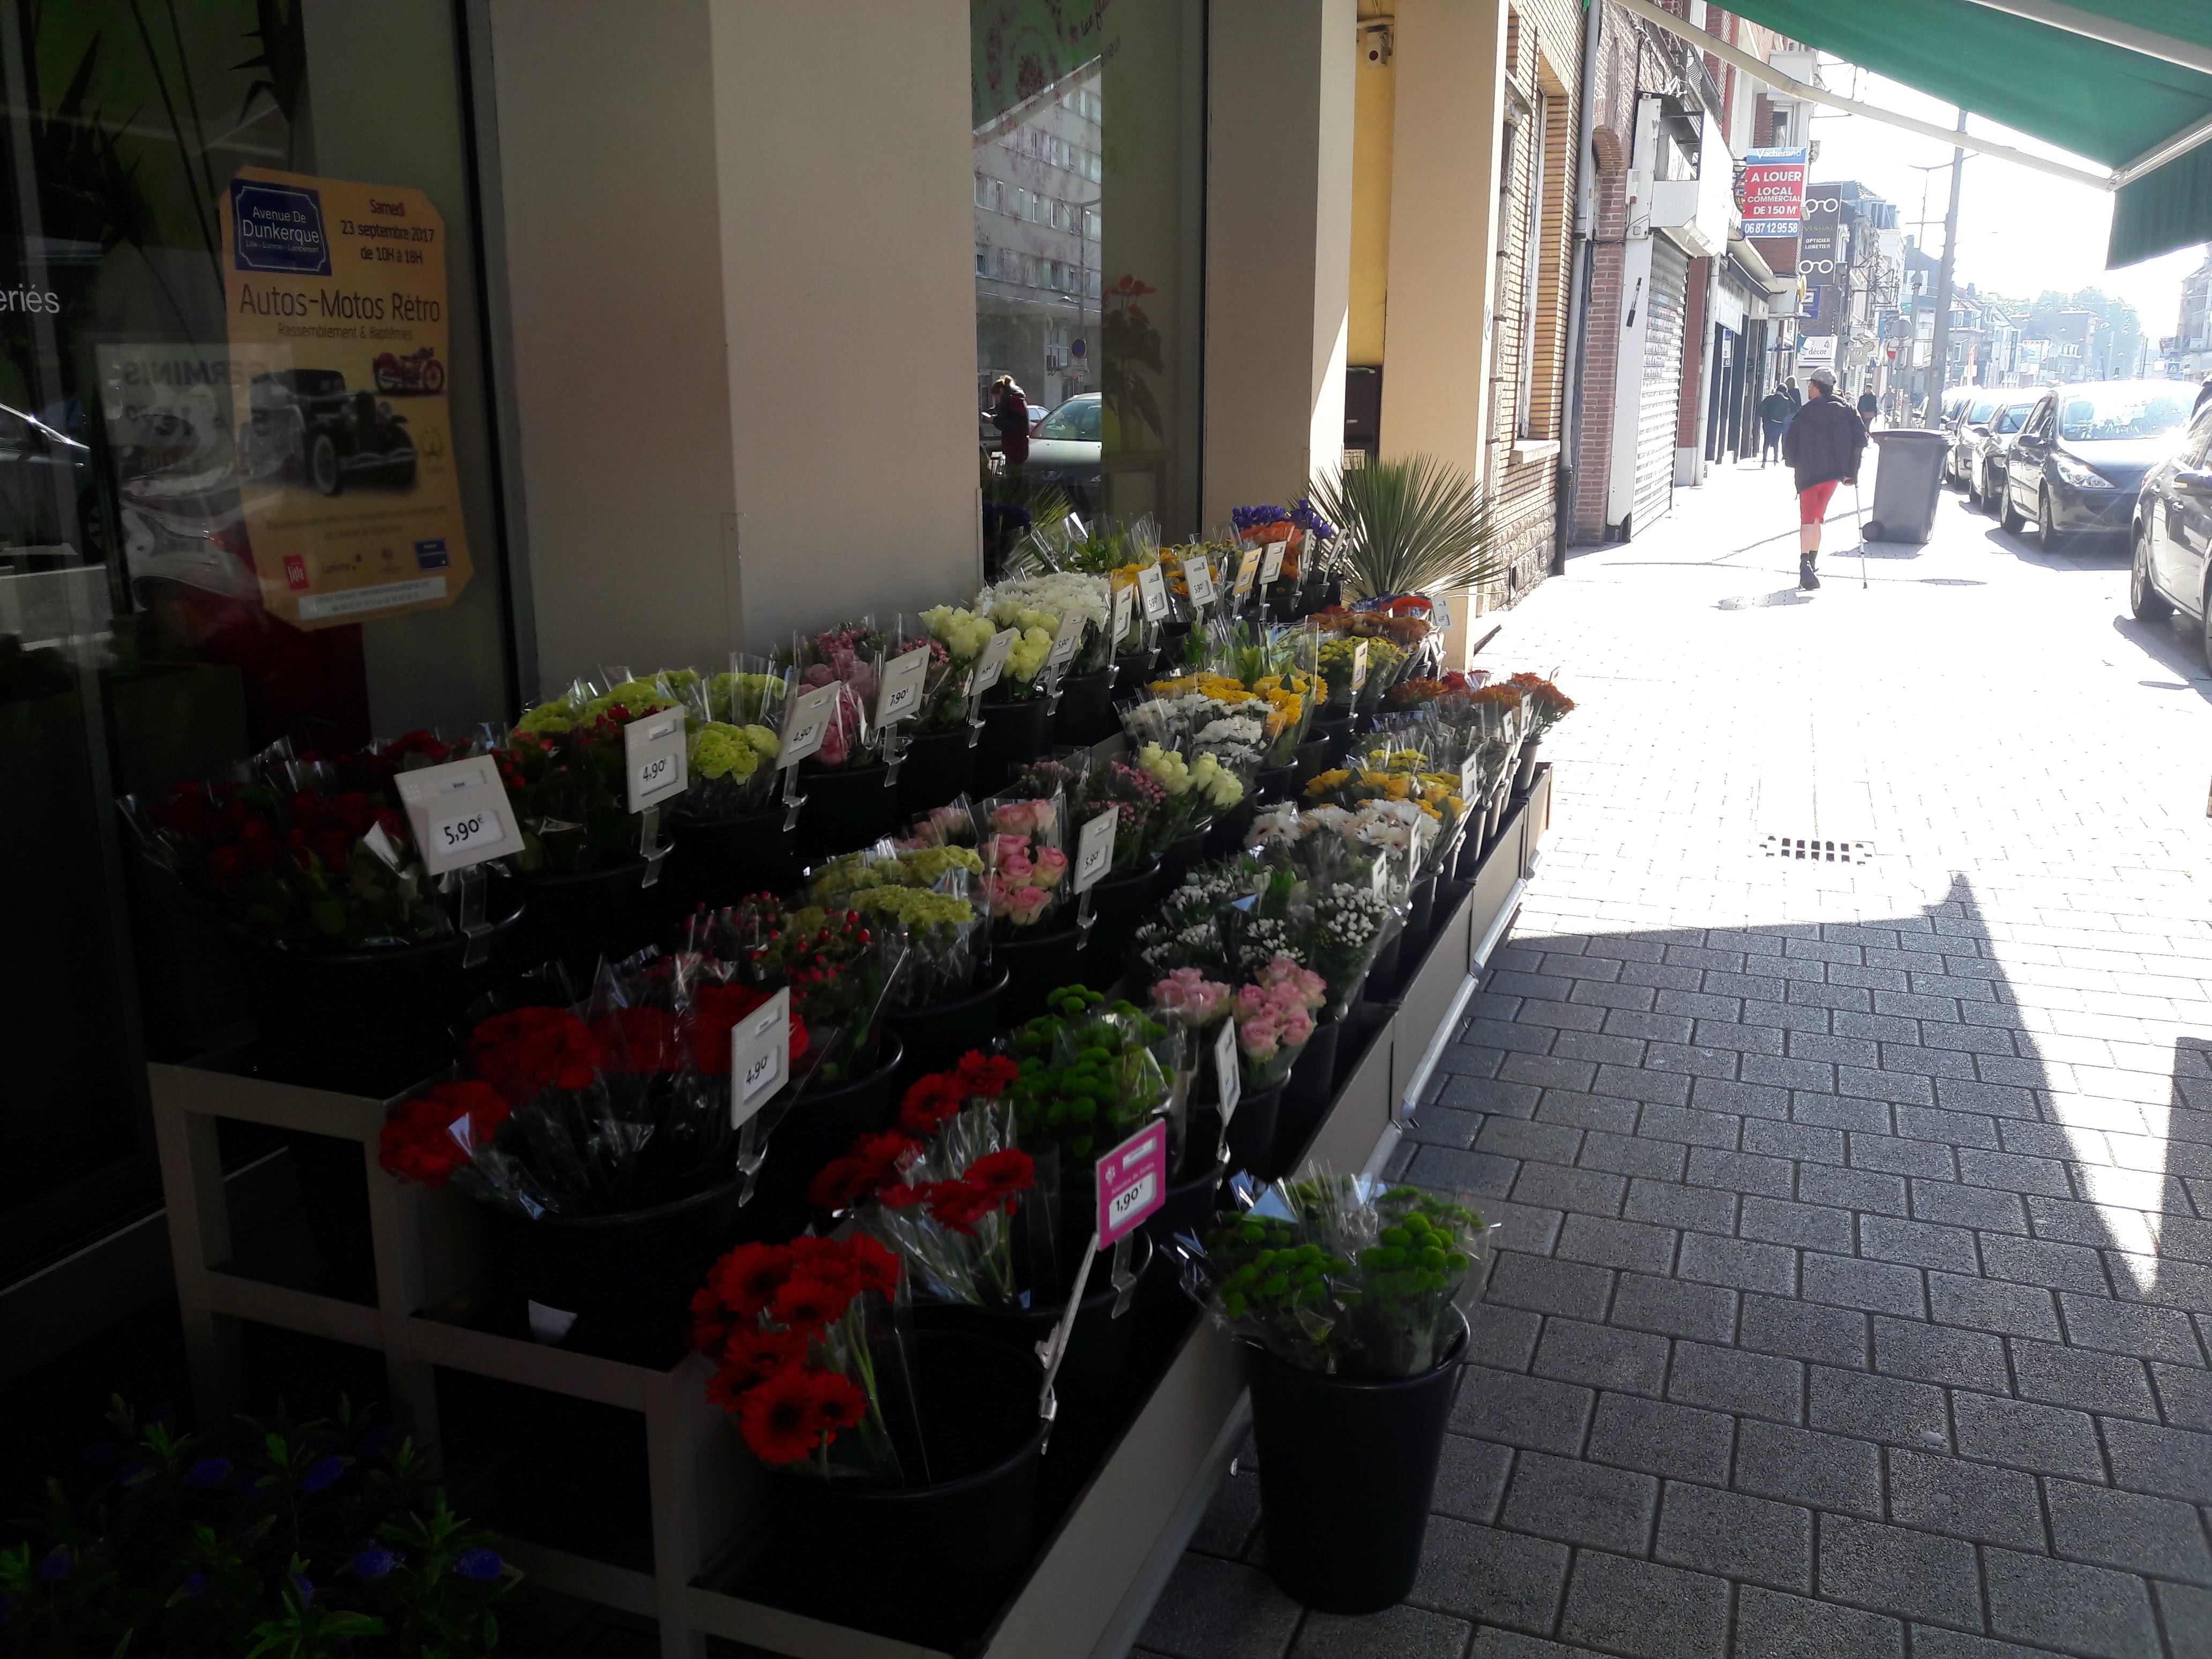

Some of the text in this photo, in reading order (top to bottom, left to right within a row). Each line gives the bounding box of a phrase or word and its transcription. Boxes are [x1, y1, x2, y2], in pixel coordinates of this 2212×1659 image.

[1755, 148, 1803, 159] Vacherand
[1751, 171, 1802, 183] A LOUER
[1747, 195, 1802, 203] COMMERCIAL
[1757, 186, 1793, 196] LOCAL
[253, 206, 307, 223] Avenue De
[370, 198, 405, 217] Samedi
[1753, 206, 1766, 215] DE
[1767, 206, 1785, 215] 150
[243, 220, 320, 246] Dunkerque
[340, 220, 435, 243] 23 septembre 2017
[1745, 222, 1798, 234] 06 87 12 95 58
[361, 245, 373, 260] de
[377, 246, 395, 262] 10H
[406, 248, 423, 265] 18H
[240, 283, 440, 322] Autos-Motos Rétro
[278, 323, 357, 338] Rassemblement
[443, 813, 485, 846] 5,90€
